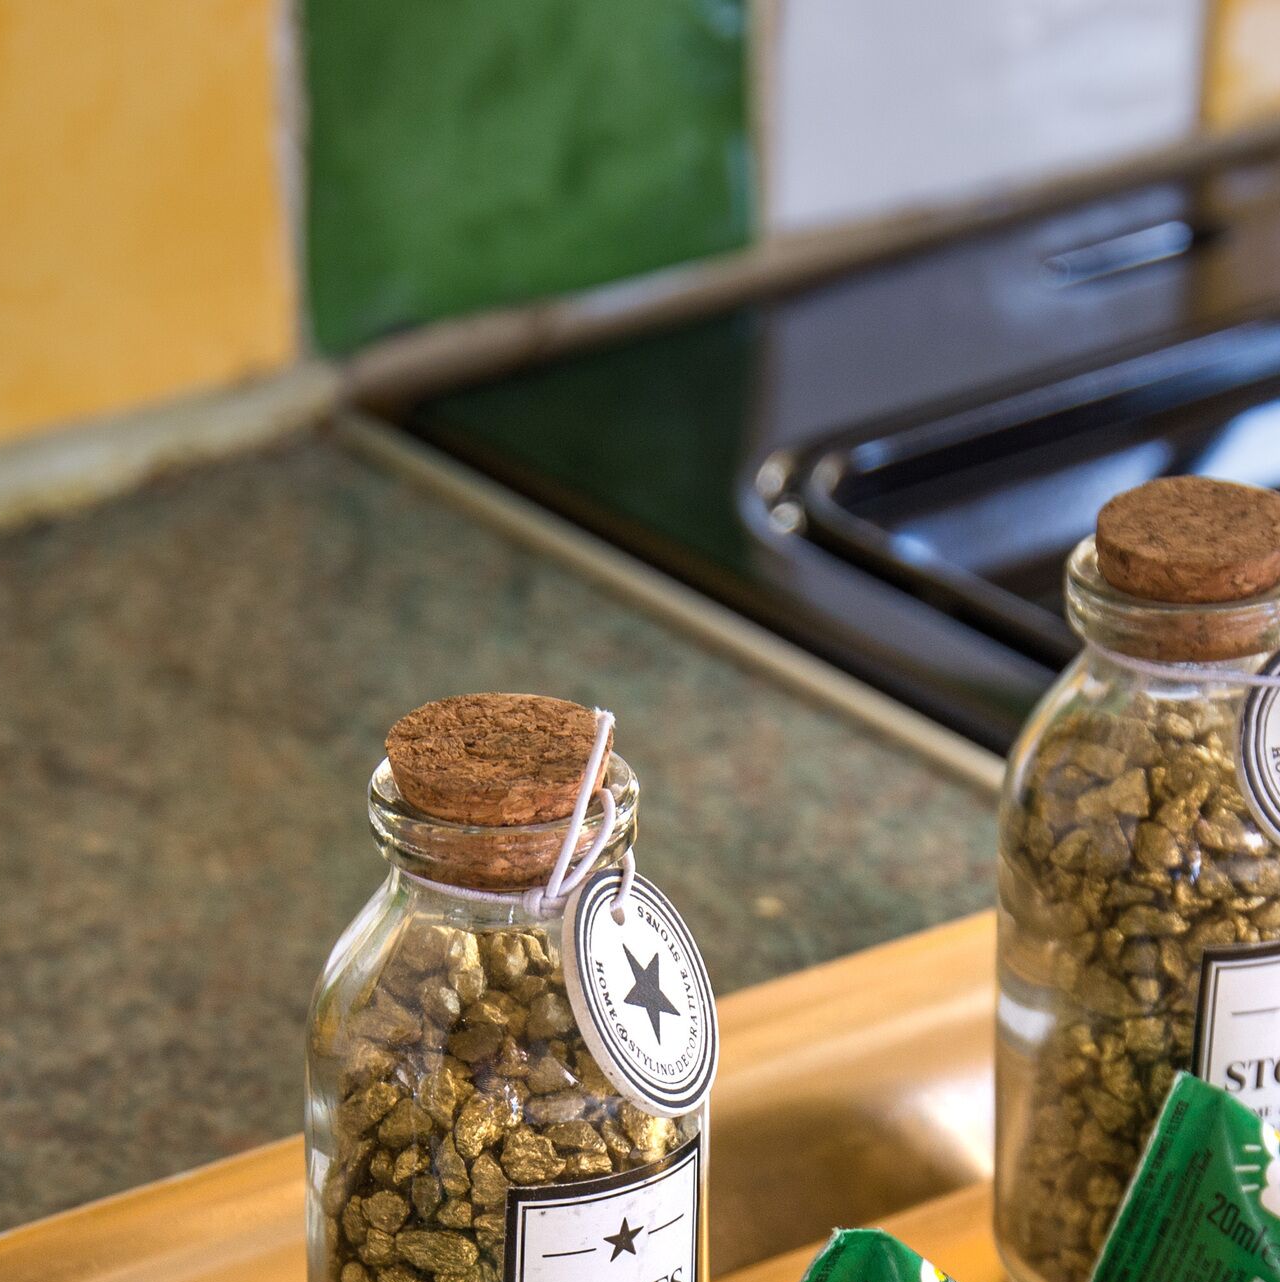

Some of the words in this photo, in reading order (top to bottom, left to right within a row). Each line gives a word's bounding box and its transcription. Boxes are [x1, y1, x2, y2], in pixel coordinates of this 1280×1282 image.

[637, 905, 680, 963] STONES
[594, 960, 618, 1022] HOME
[675, 968, 700, 1074] DECORATIVE
[628, 1039, 675, 1076] STYLING
